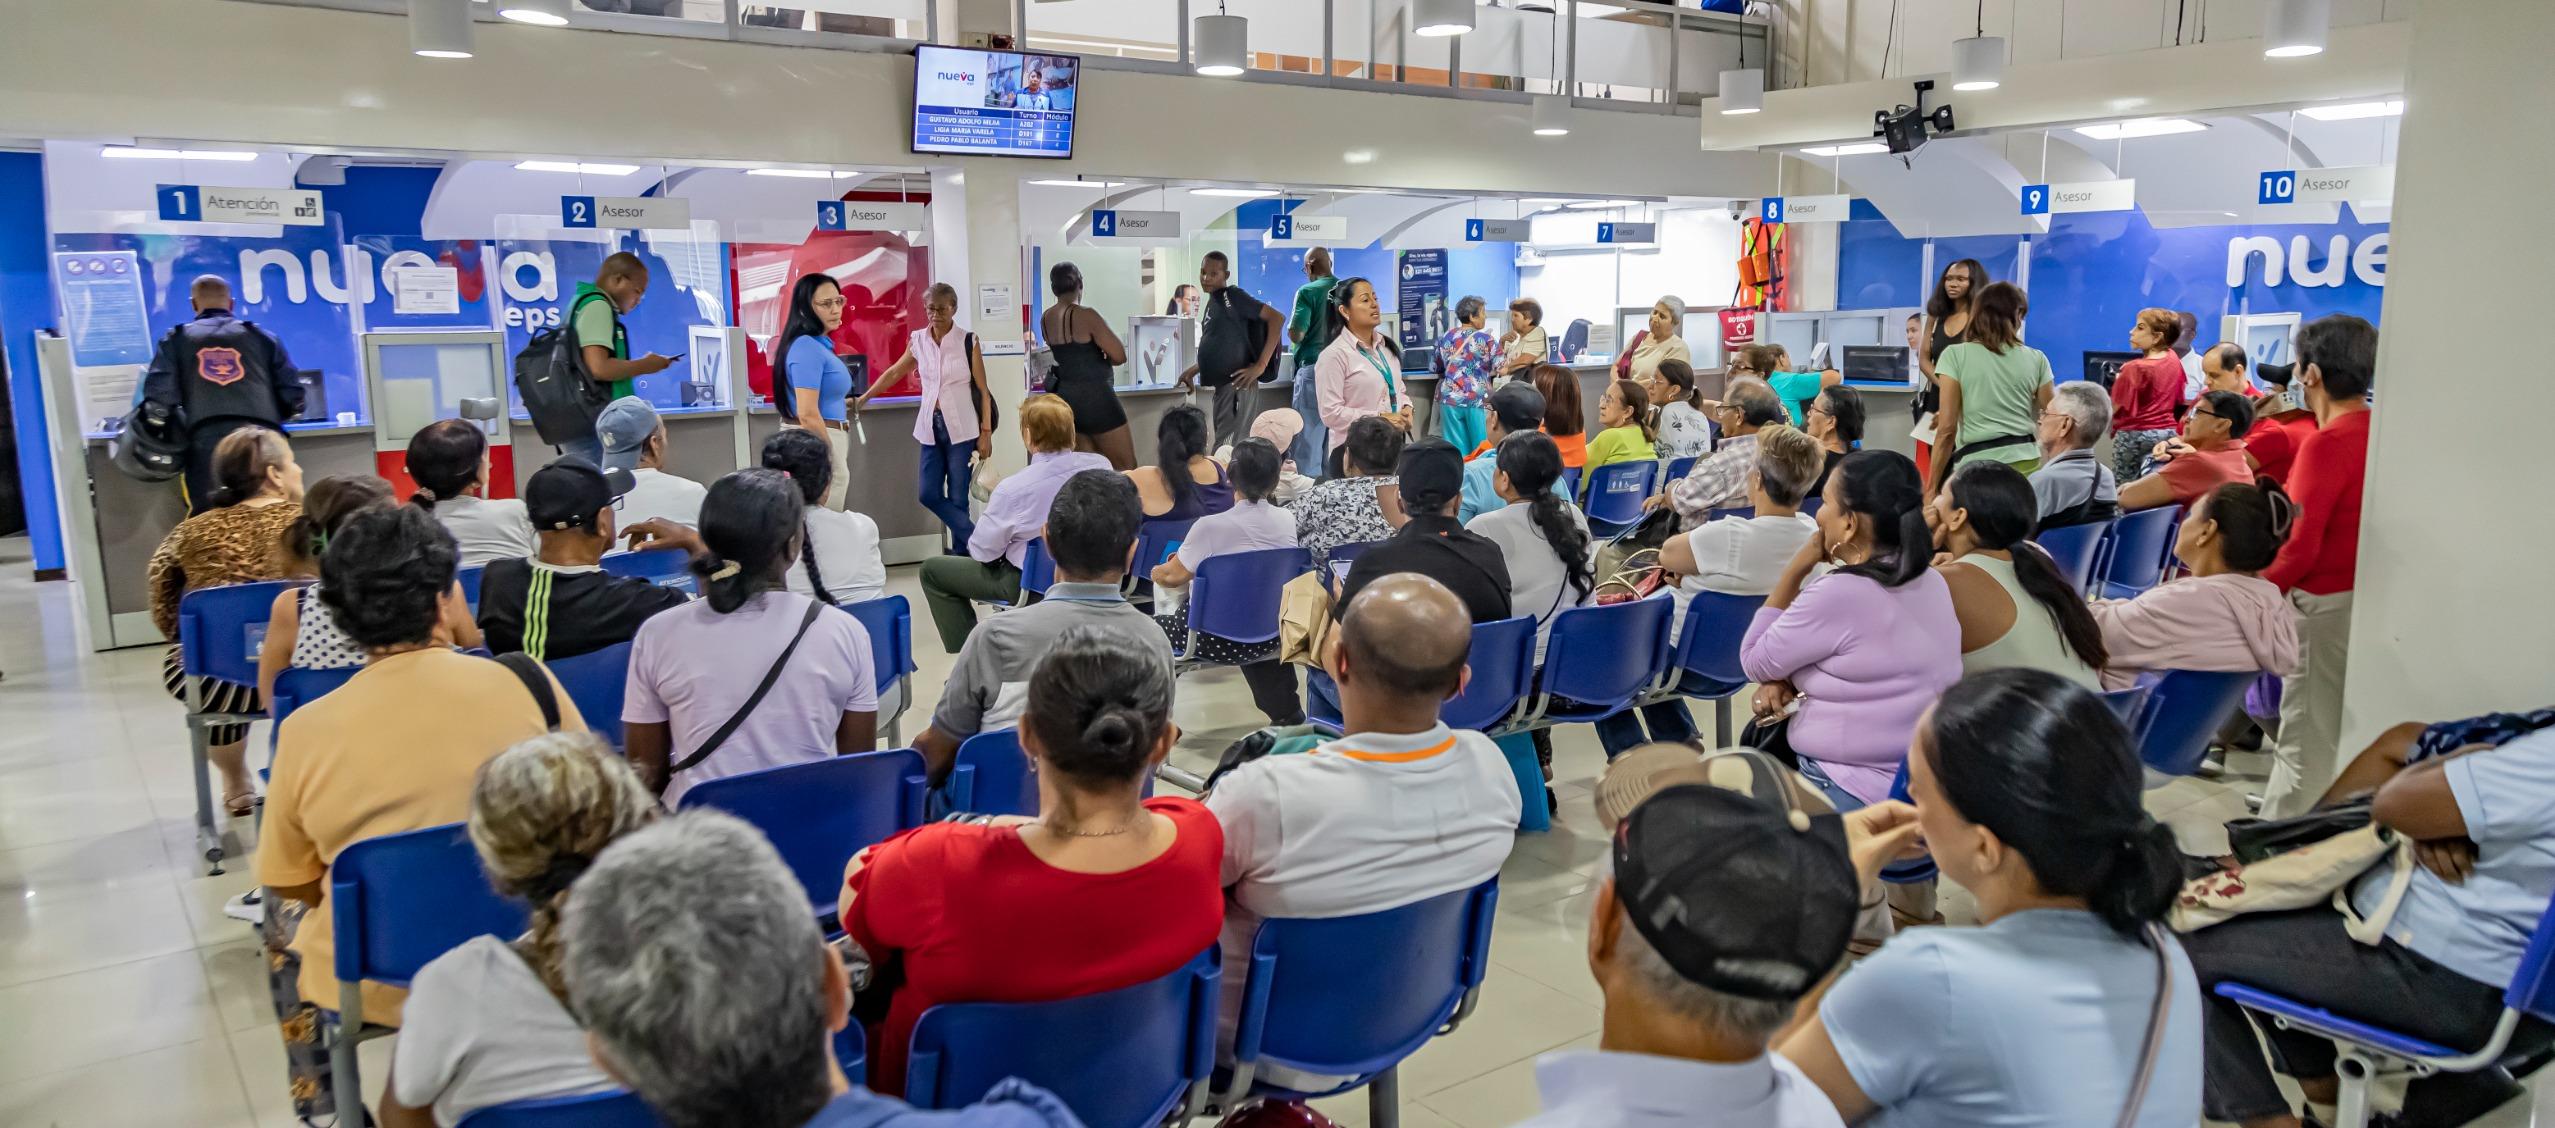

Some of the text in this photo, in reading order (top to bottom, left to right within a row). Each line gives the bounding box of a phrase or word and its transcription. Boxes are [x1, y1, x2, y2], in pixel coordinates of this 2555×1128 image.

[938, 71, 974, 82] nueva
[954, 108, 978, 116] Usuario
[2264, 176, 2350, 198] 10 Asesor
[173, 191, 279, 214] 1 Atención
[2029, 190, 2092, 209] 9 Asesor
[572, 202, 644, 222] 2 Asesor
[826, 206, 886, 225] 3 Asesor
[1768, 202, 1816, 218] 8 Asesor
[1099, 215, 1149, 232] 4 Asesor
[1278, 220, 1320, 235] 5 Asesor
[1471, 224, 1478, 238] 6
[1602, 226, 1635, 239] 7 Asesor
[504, 306, 561, 334] eps
